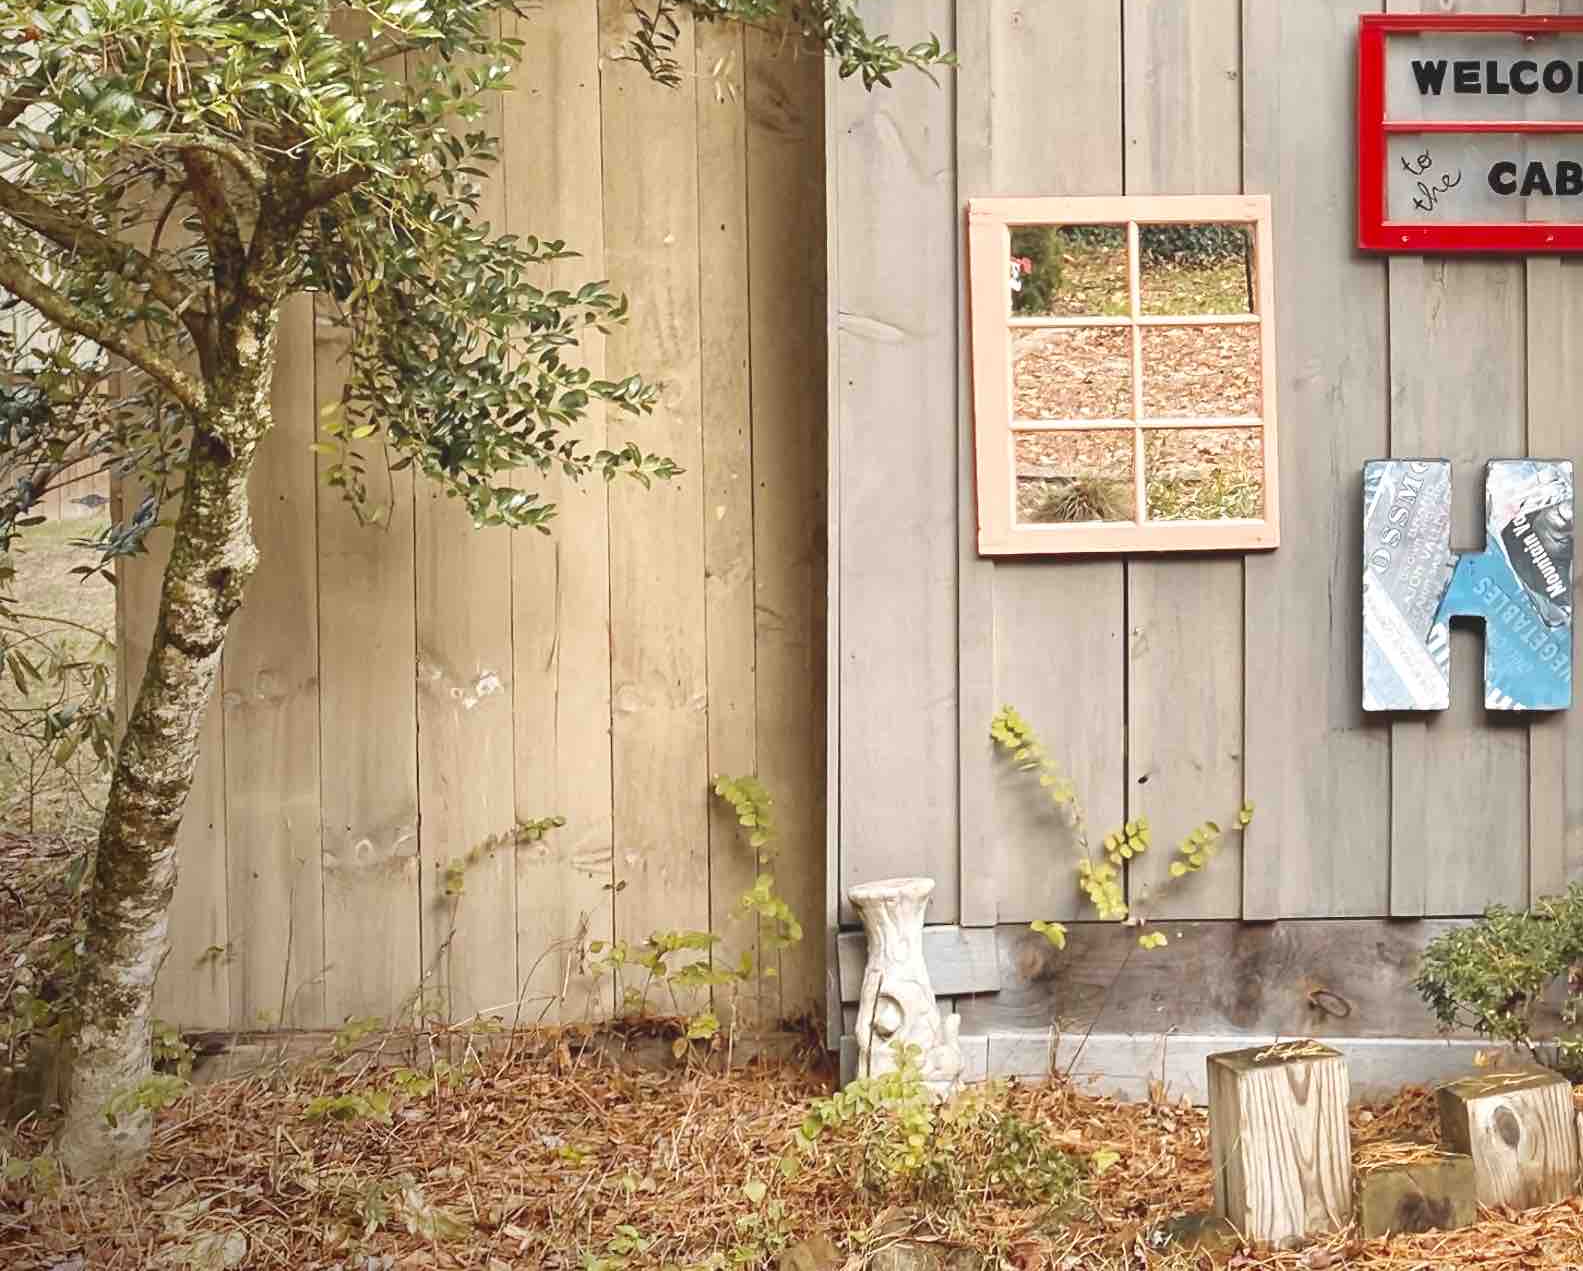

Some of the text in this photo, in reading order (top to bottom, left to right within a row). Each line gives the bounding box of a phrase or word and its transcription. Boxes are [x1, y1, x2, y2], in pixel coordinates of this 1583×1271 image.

[1401, 149, 1433, 176] to
[1412, 170, 1462, 212] the
[1523, 532, 1567, 599] Mountain
